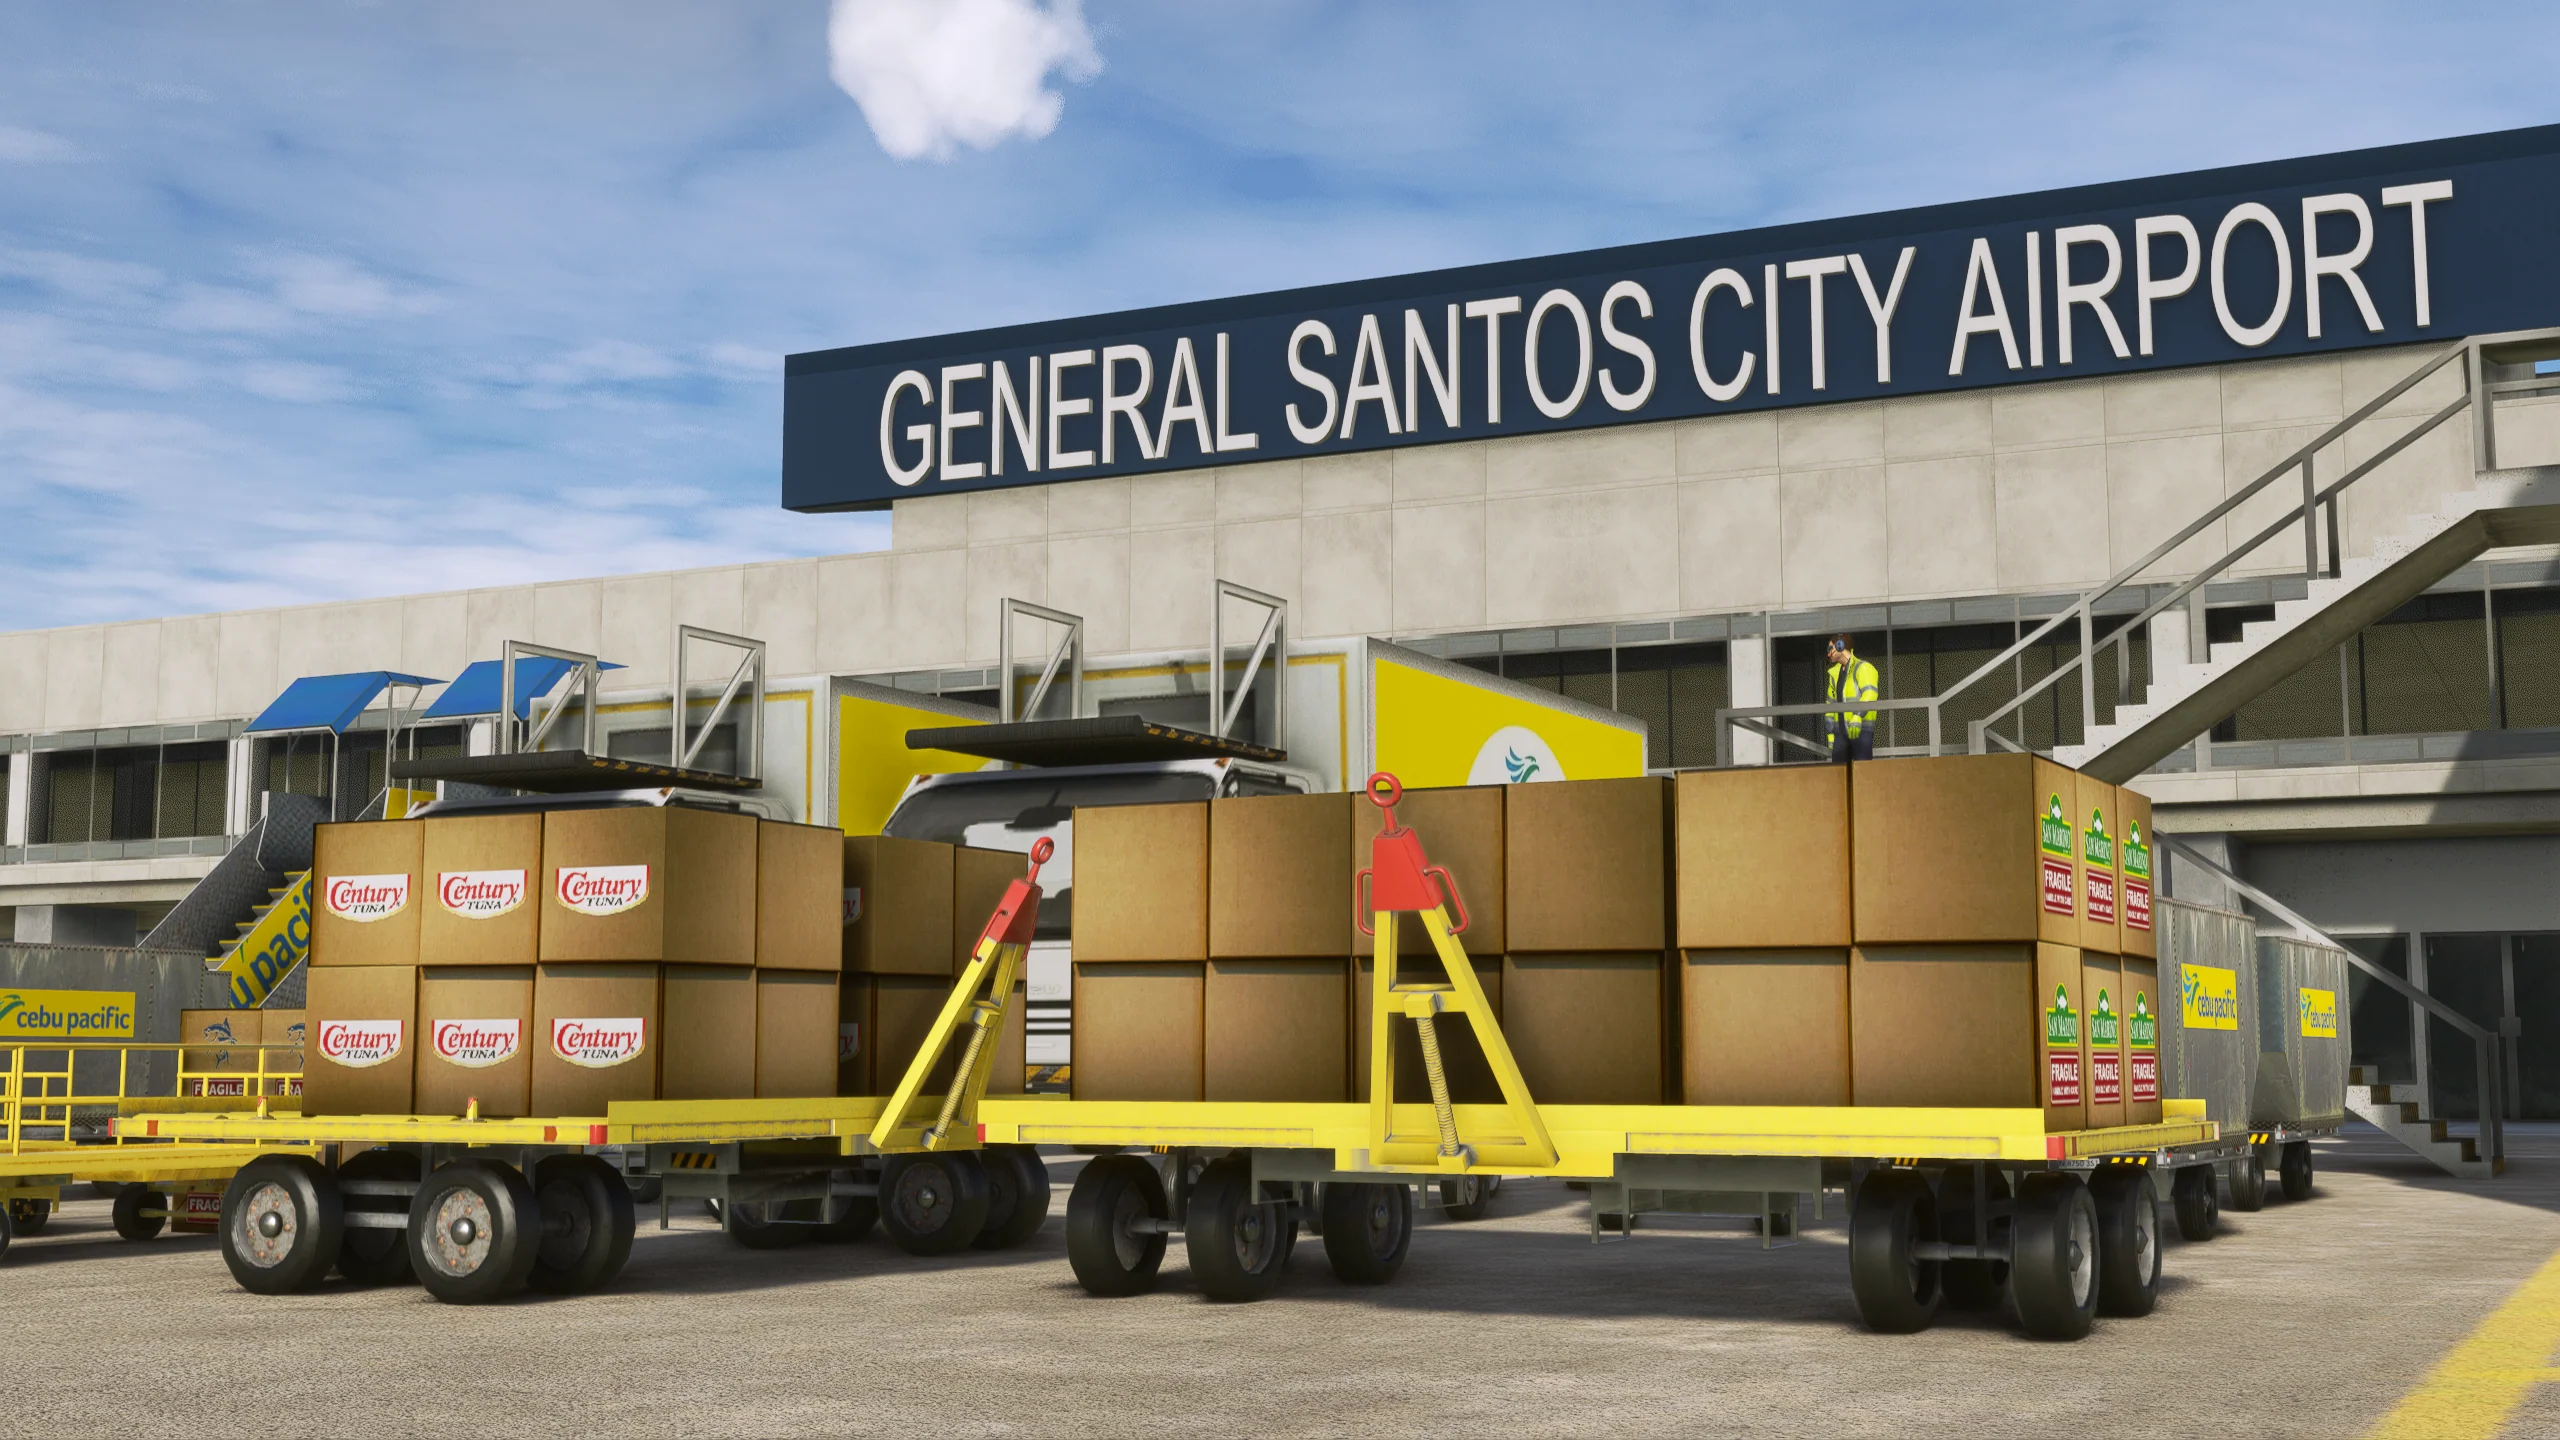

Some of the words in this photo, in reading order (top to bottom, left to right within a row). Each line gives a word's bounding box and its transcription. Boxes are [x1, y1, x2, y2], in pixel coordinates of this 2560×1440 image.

[879, 332, 1259, 487] GENERAL
[1285, 280, 1655, 445] SANTOS
[1689, 246, 1917, 402] CITY
[1948, 178, 2453, 376] AIRPORT
[557, 872, 641, 908] Century
[2044, 869, 2072, 892] FRAGILE
[2088, 879, 2113, 902] FRAGILE
[330, 880, 403, 911] Century
[443, 876, 519, 909] Century
[586, 897, 623, 907] TUNA
[2126, 889, 2149, 910] FRAGILE
[353, 903, 386, 914] TUNA
[467, 900, 502, 911] TUNA
[250, 879, 311, 995] paci
[2198, 987, 2214, 1018] cebu
[2214, 988, 2236, 1026] pacific
[17, 1004, 63, 1028] cebu
[67, 1006, 130, 1035] pacific
[2310, 1006, 2321, 1028] cebu
[2321, 1006, 2335, 1035] pacific
[323, 1024, 396, 1056] Century
[437, 1024, 514, 1056] Century
[557, 1023, 637, 1056] Century
[345, 1049, 379, 1059] TUNA
[460, 1049, 496, 1059] TUNA
[581, 1048, 619, 1059] TUNA
[2051, 1063, 2078, 1082] FRAGILE
[2094, 1063, 2119, 1081] FRAGILE
[2133, 1063, 2155, 1080] FRAGILE
[190, 1199, 219, 1211] FRAG
